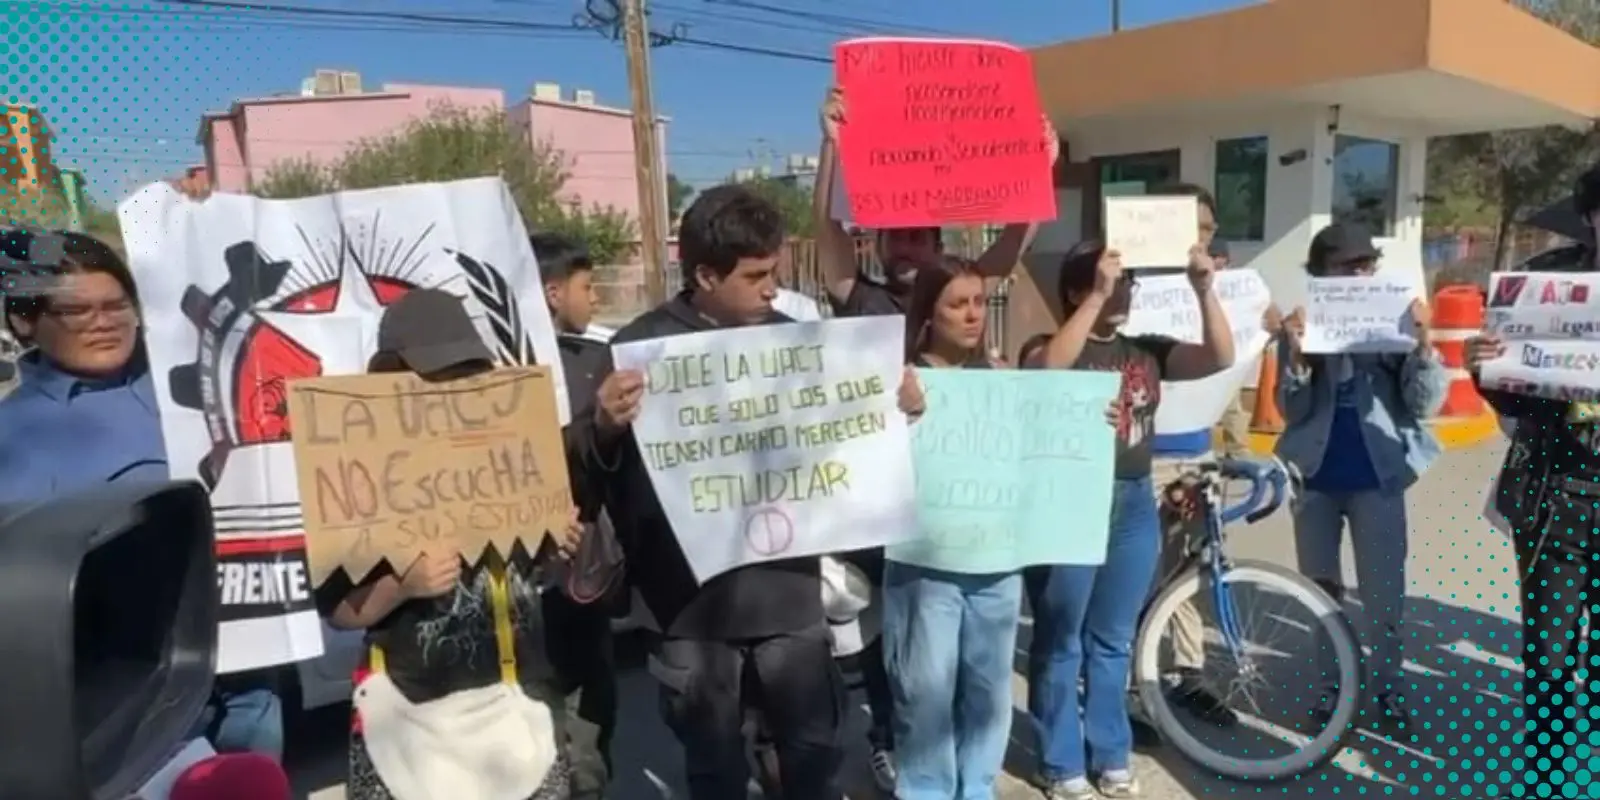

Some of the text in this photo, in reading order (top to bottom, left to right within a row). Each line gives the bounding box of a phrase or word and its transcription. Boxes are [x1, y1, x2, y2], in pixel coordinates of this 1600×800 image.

[724, 352, 752, 383] LA
[302, 390, 378, 446] LA
[678, 375, 884, 428] QUE SOLO LOS QUE
[645, 411, 886, 471] TIENEN CARRO MERECEN
[315, 453, 379, 524] NO
[689, 460, 851, 513] ESTUDIAR
